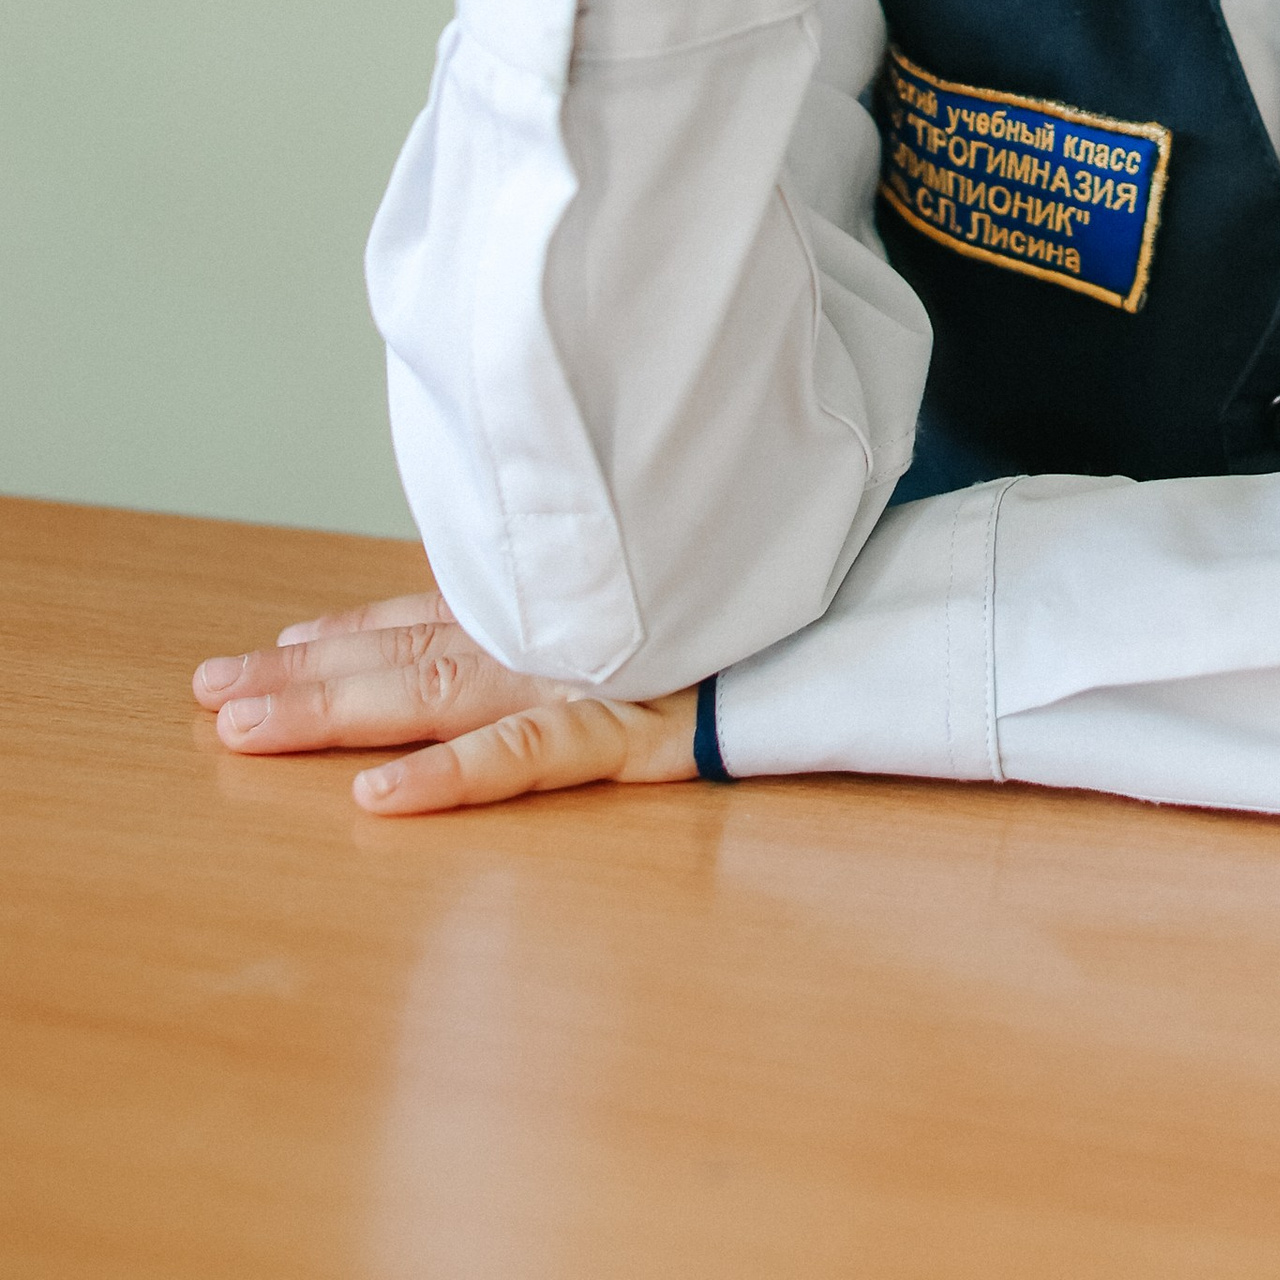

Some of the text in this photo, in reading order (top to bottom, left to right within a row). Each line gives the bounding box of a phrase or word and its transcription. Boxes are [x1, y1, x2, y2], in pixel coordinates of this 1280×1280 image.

[907, 112, 1138, 214] "ПРОГИМНАЗИЯ
[945, 105, 1056, 153] учебный
[1063, 134, 1141, 175] класс
[966, 211, 1081, 274] Лисина
